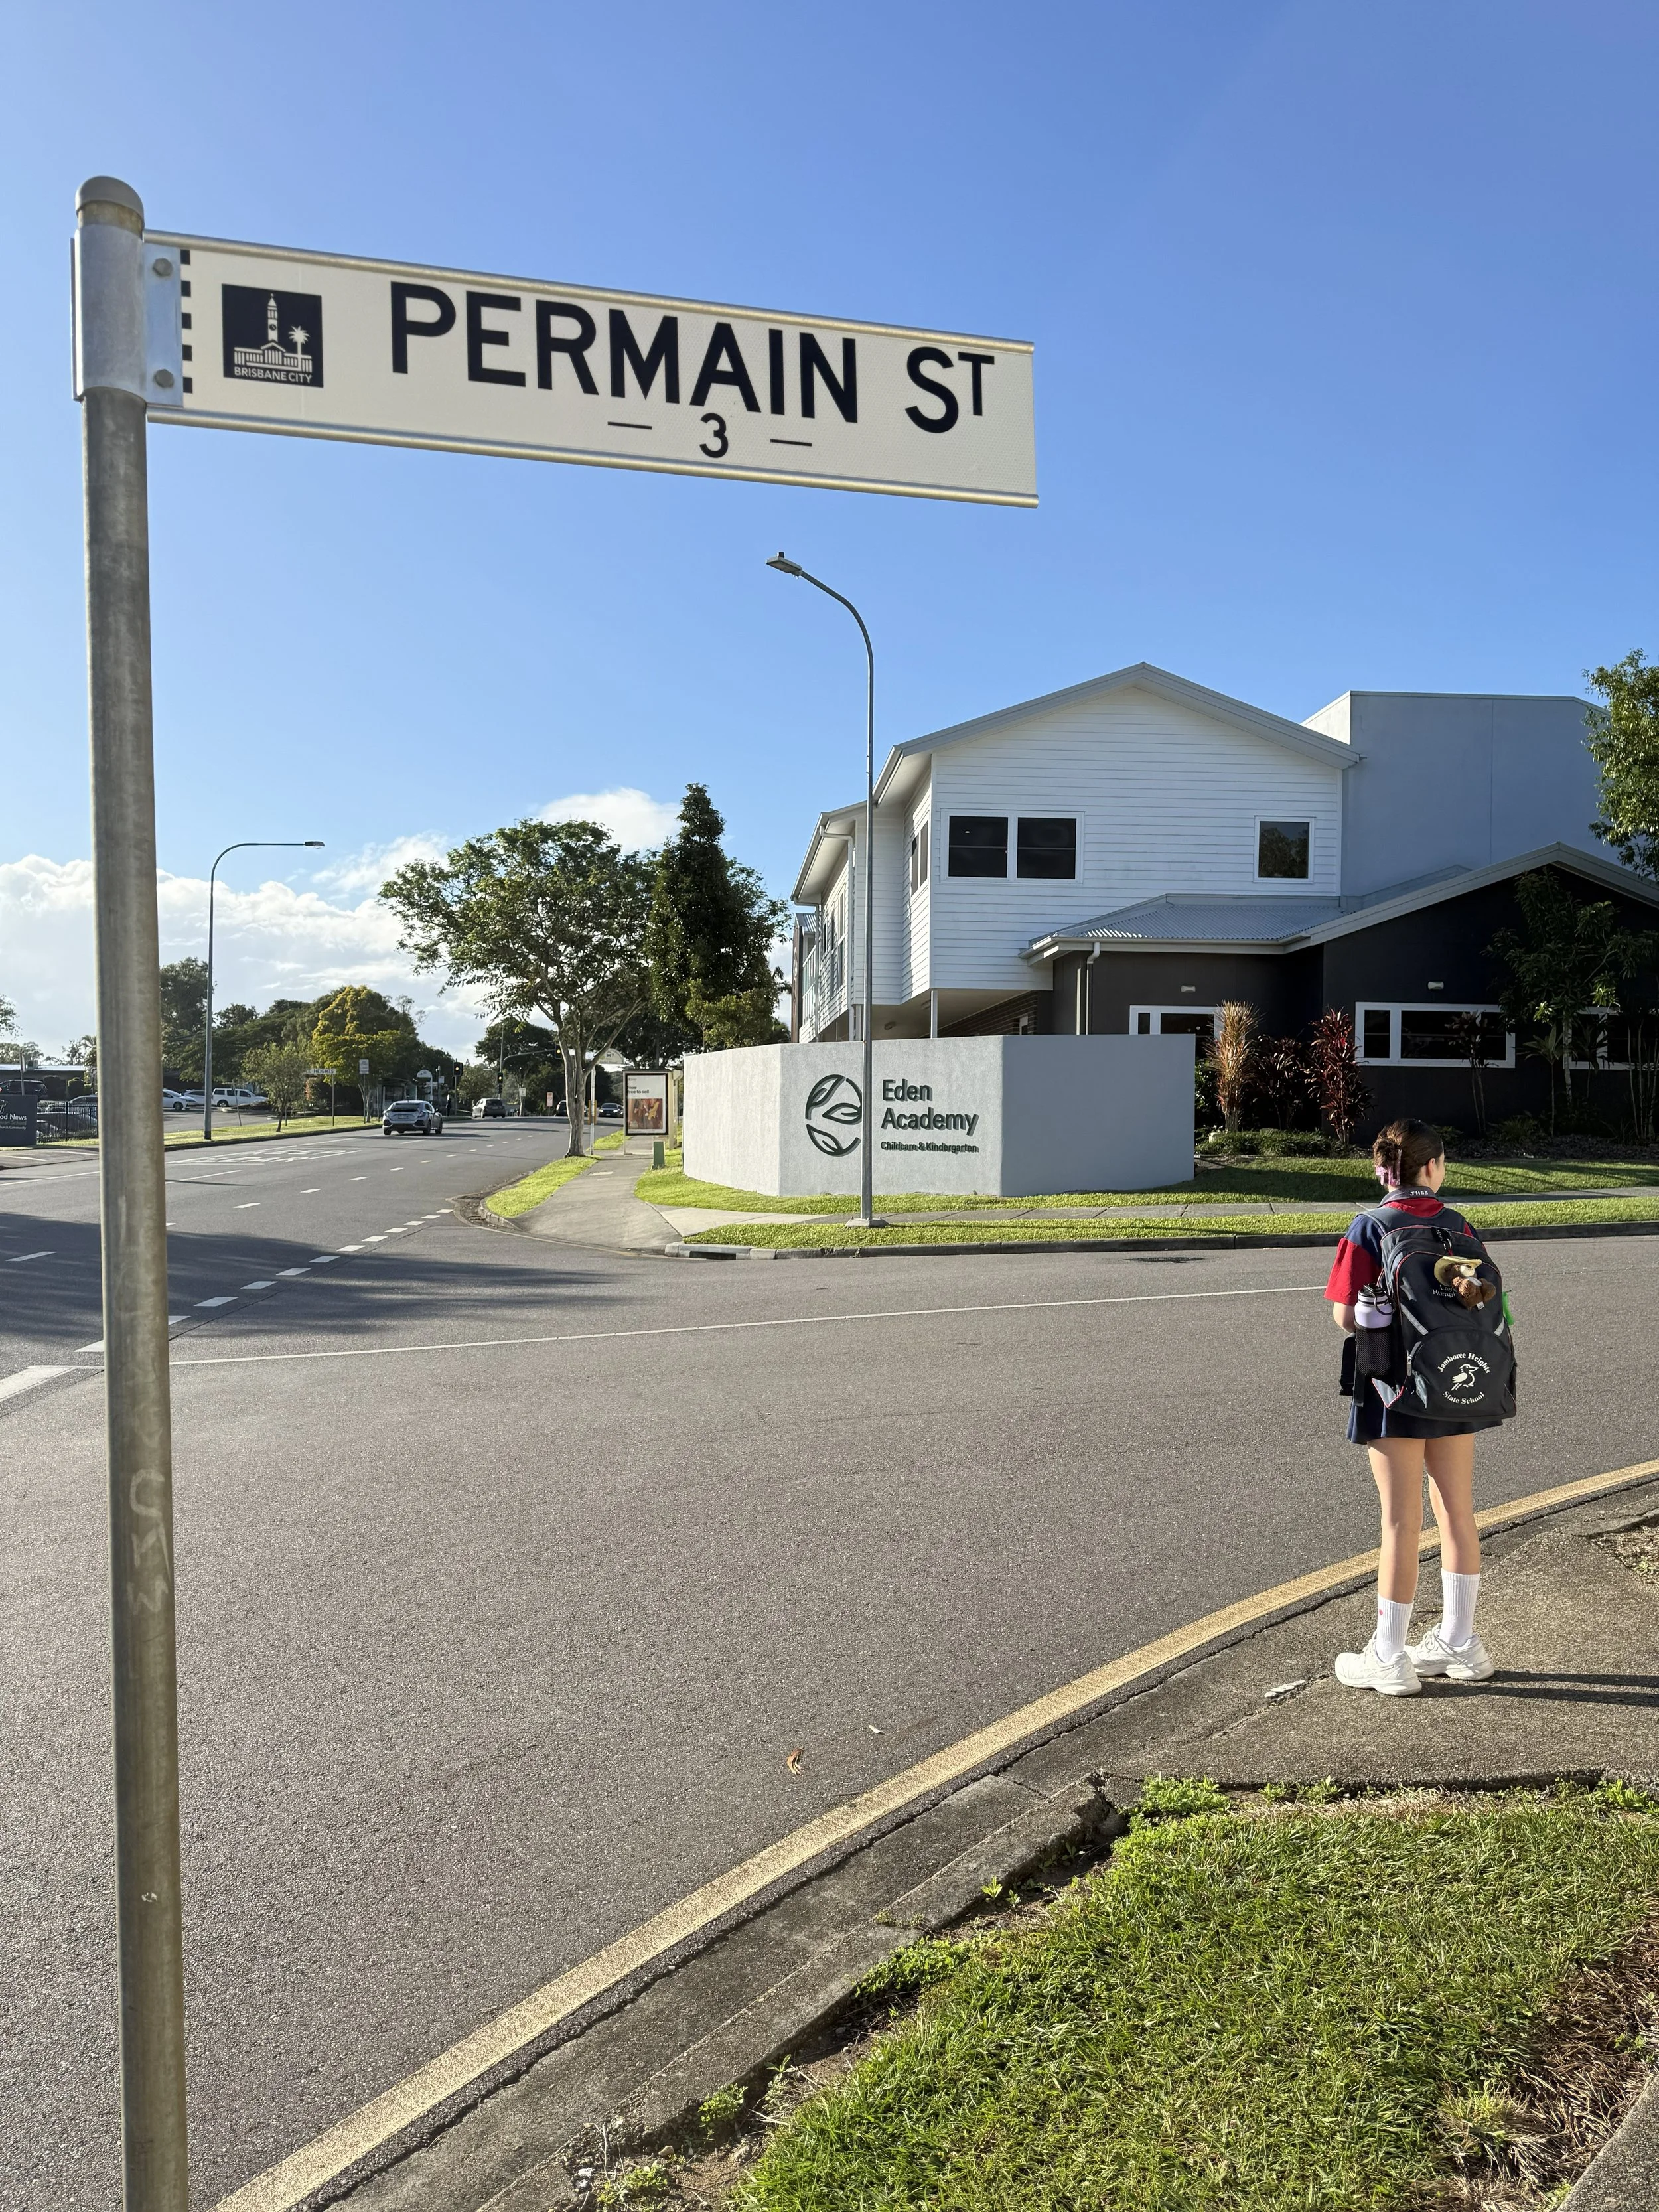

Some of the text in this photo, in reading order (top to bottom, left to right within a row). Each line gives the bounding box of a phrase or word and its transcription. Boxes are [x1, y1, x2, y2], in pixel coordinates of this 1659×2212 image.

[390, 281, 995, 433] PERMAIN ST
[234, 366, 313, 384] BRISBANE CITY
[699, 412, 729, 458] 3
[883, 1078, 932, 1102] Eden
[881, 1106, 979, 1136] Academy
[881, 1141, 979, 1154] Childcare & Kindergarten
[1437, 1352, 1490, 1374] Jamboree Heights
[1443, 1391, 1485, 1404] State School
